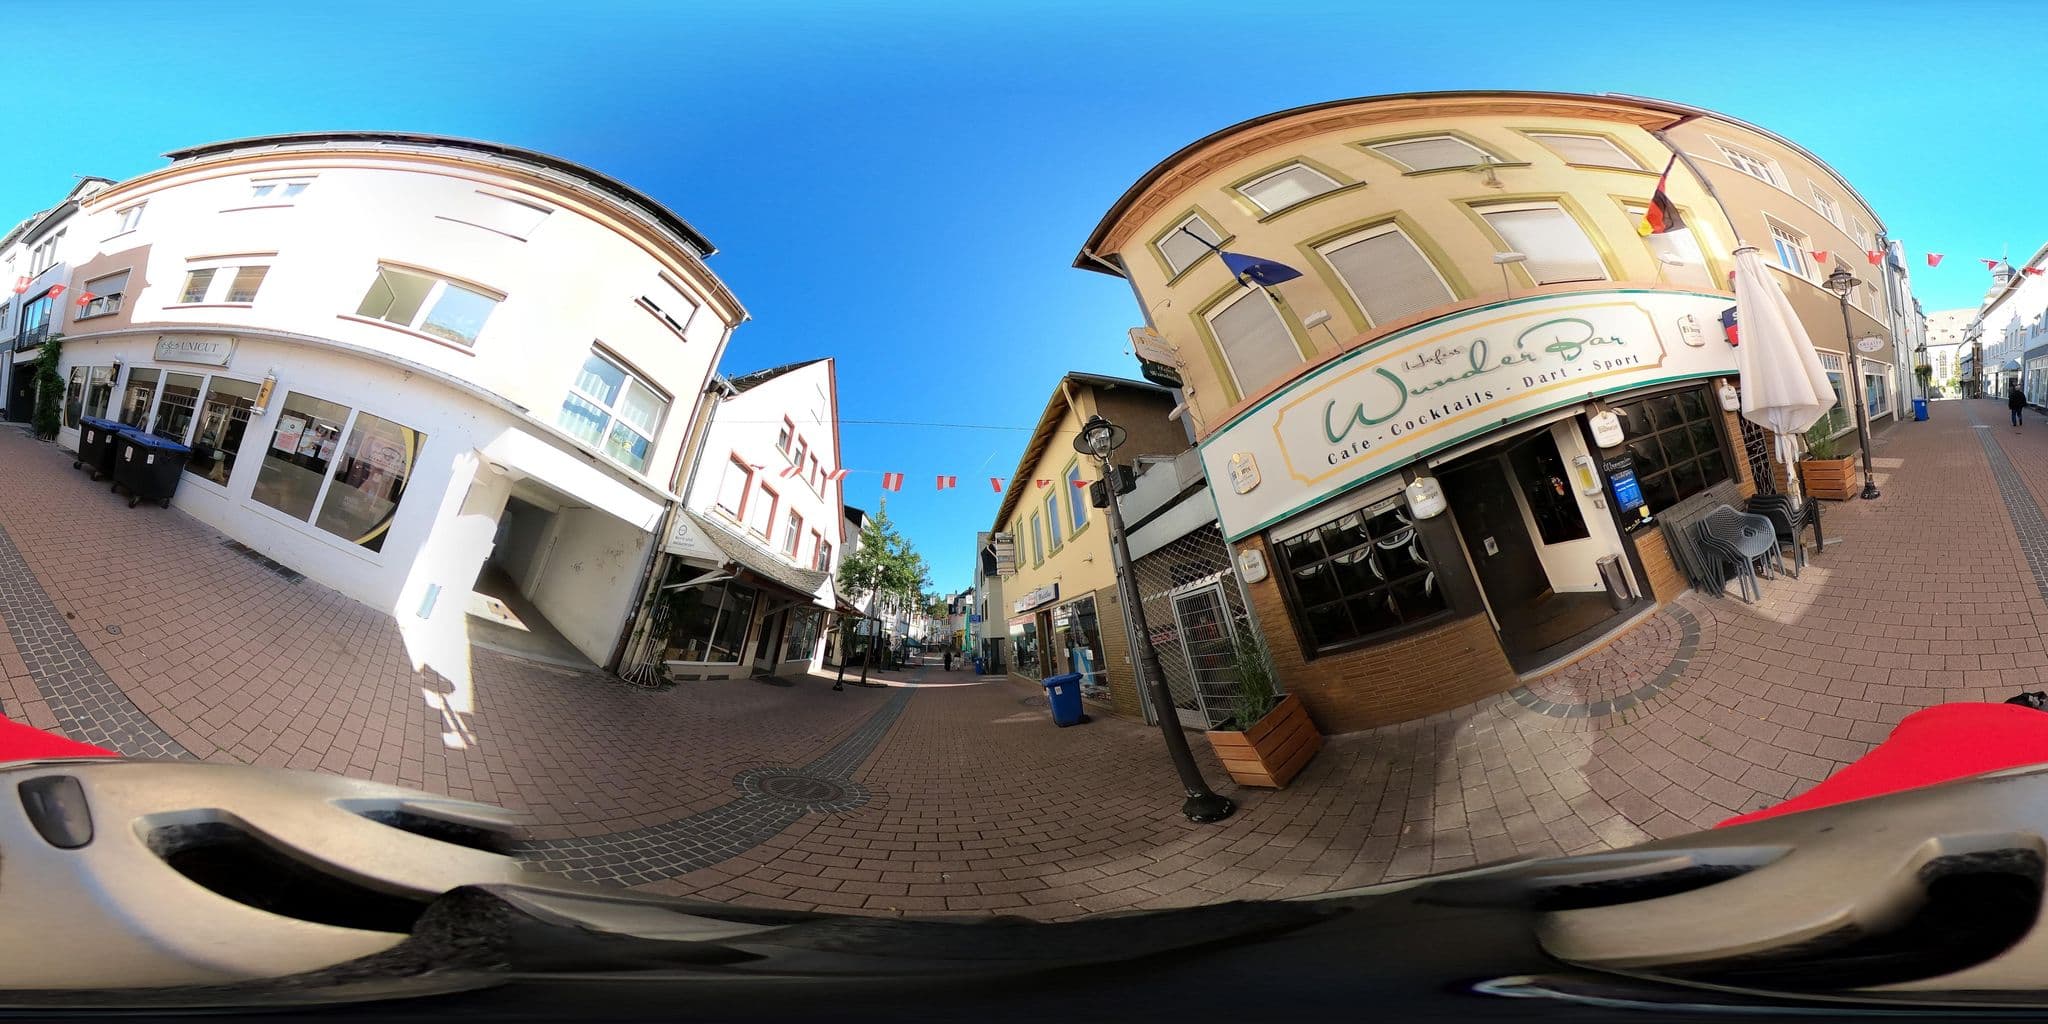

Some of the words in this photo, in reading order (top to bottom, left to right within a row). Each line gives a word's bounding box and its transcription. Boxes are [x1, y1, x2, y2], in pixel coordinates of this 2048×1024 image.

[181, 342, 219, 353] UNICUT
[1325, 340, 1536, 443] Wunder
[1517, 317, 1624, 361] Bar
[1327, 439, 1371, 465] Cafe
[1390, 390, 1494, 436] Cocktails
[1523, 367, 1568, 388] Dart
[1592, 354, 1639, 371] Sport
